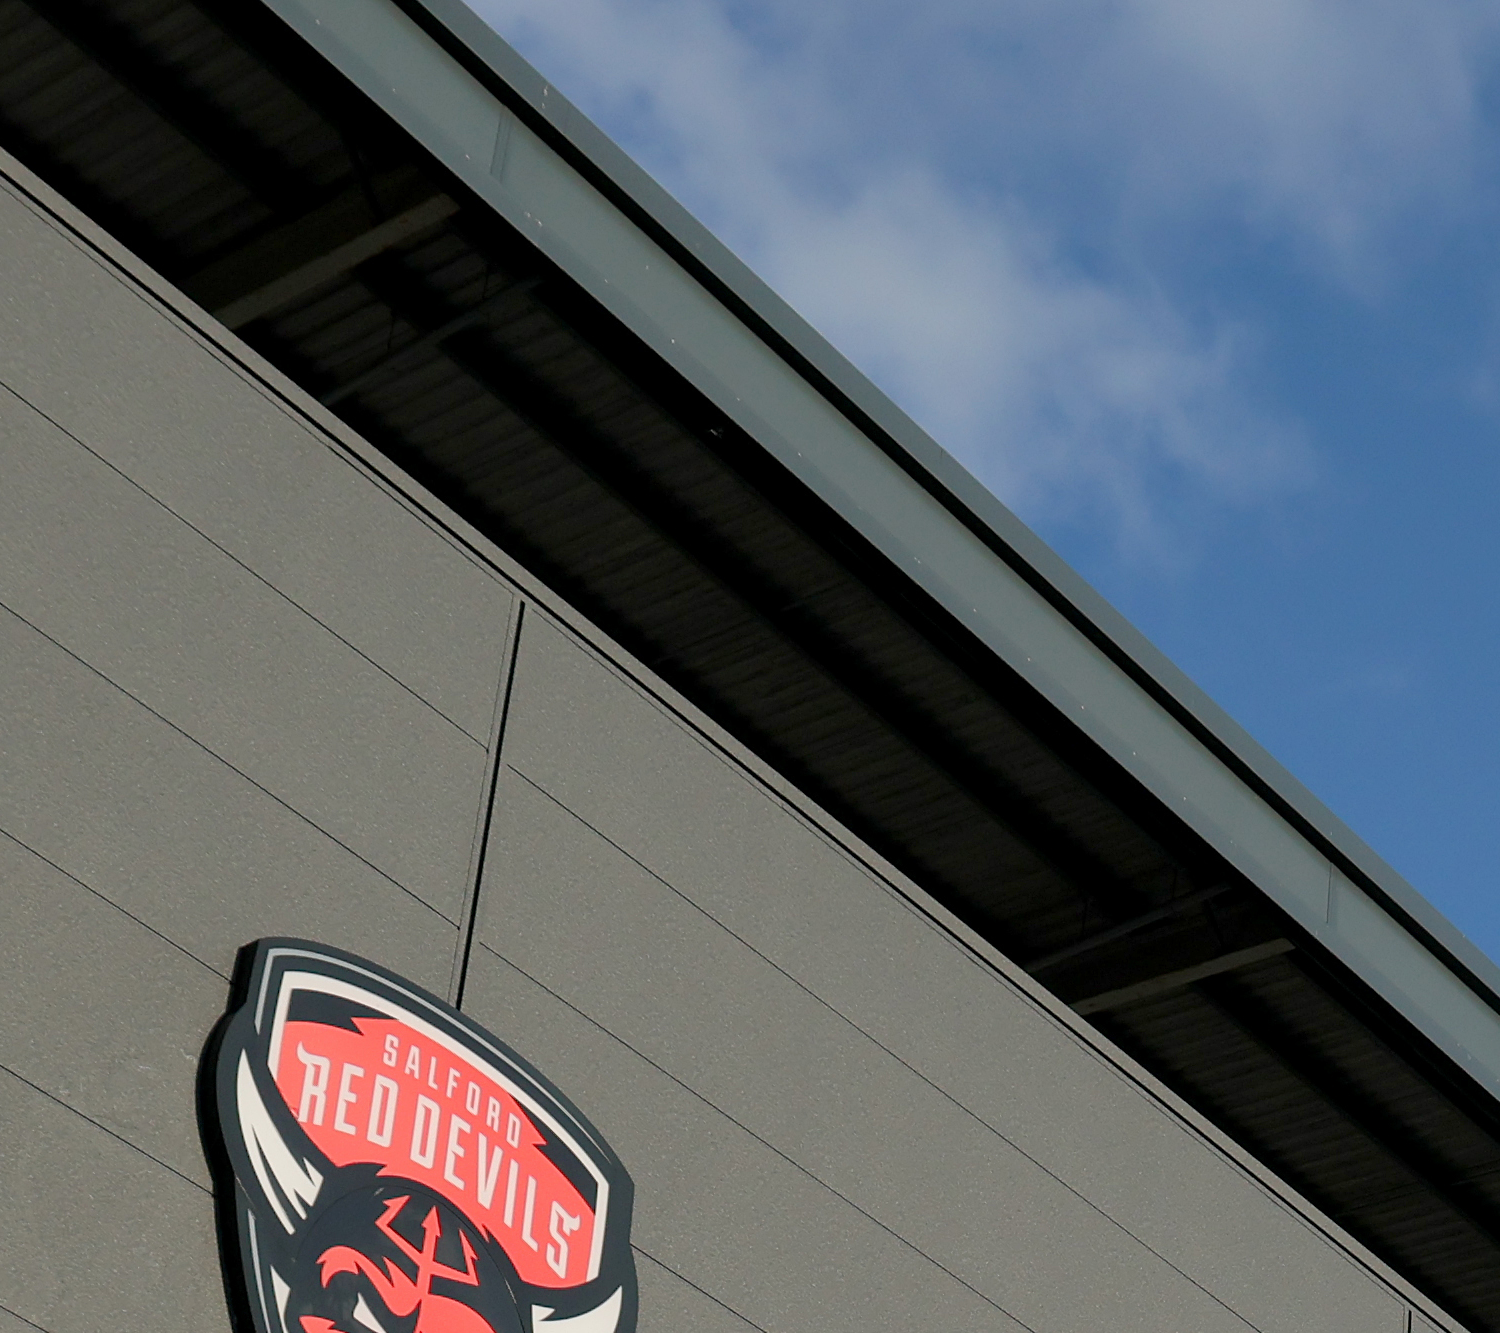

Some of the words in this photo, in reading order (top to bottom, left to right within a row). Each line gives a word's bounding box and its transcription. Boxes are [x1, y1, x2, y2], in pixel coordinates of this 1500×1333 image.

[297, 1040, 394, 1148] RED
[410, 1097, 580, 1279] DEVILS
[383, 1033, 521, 1145] SALFORD
